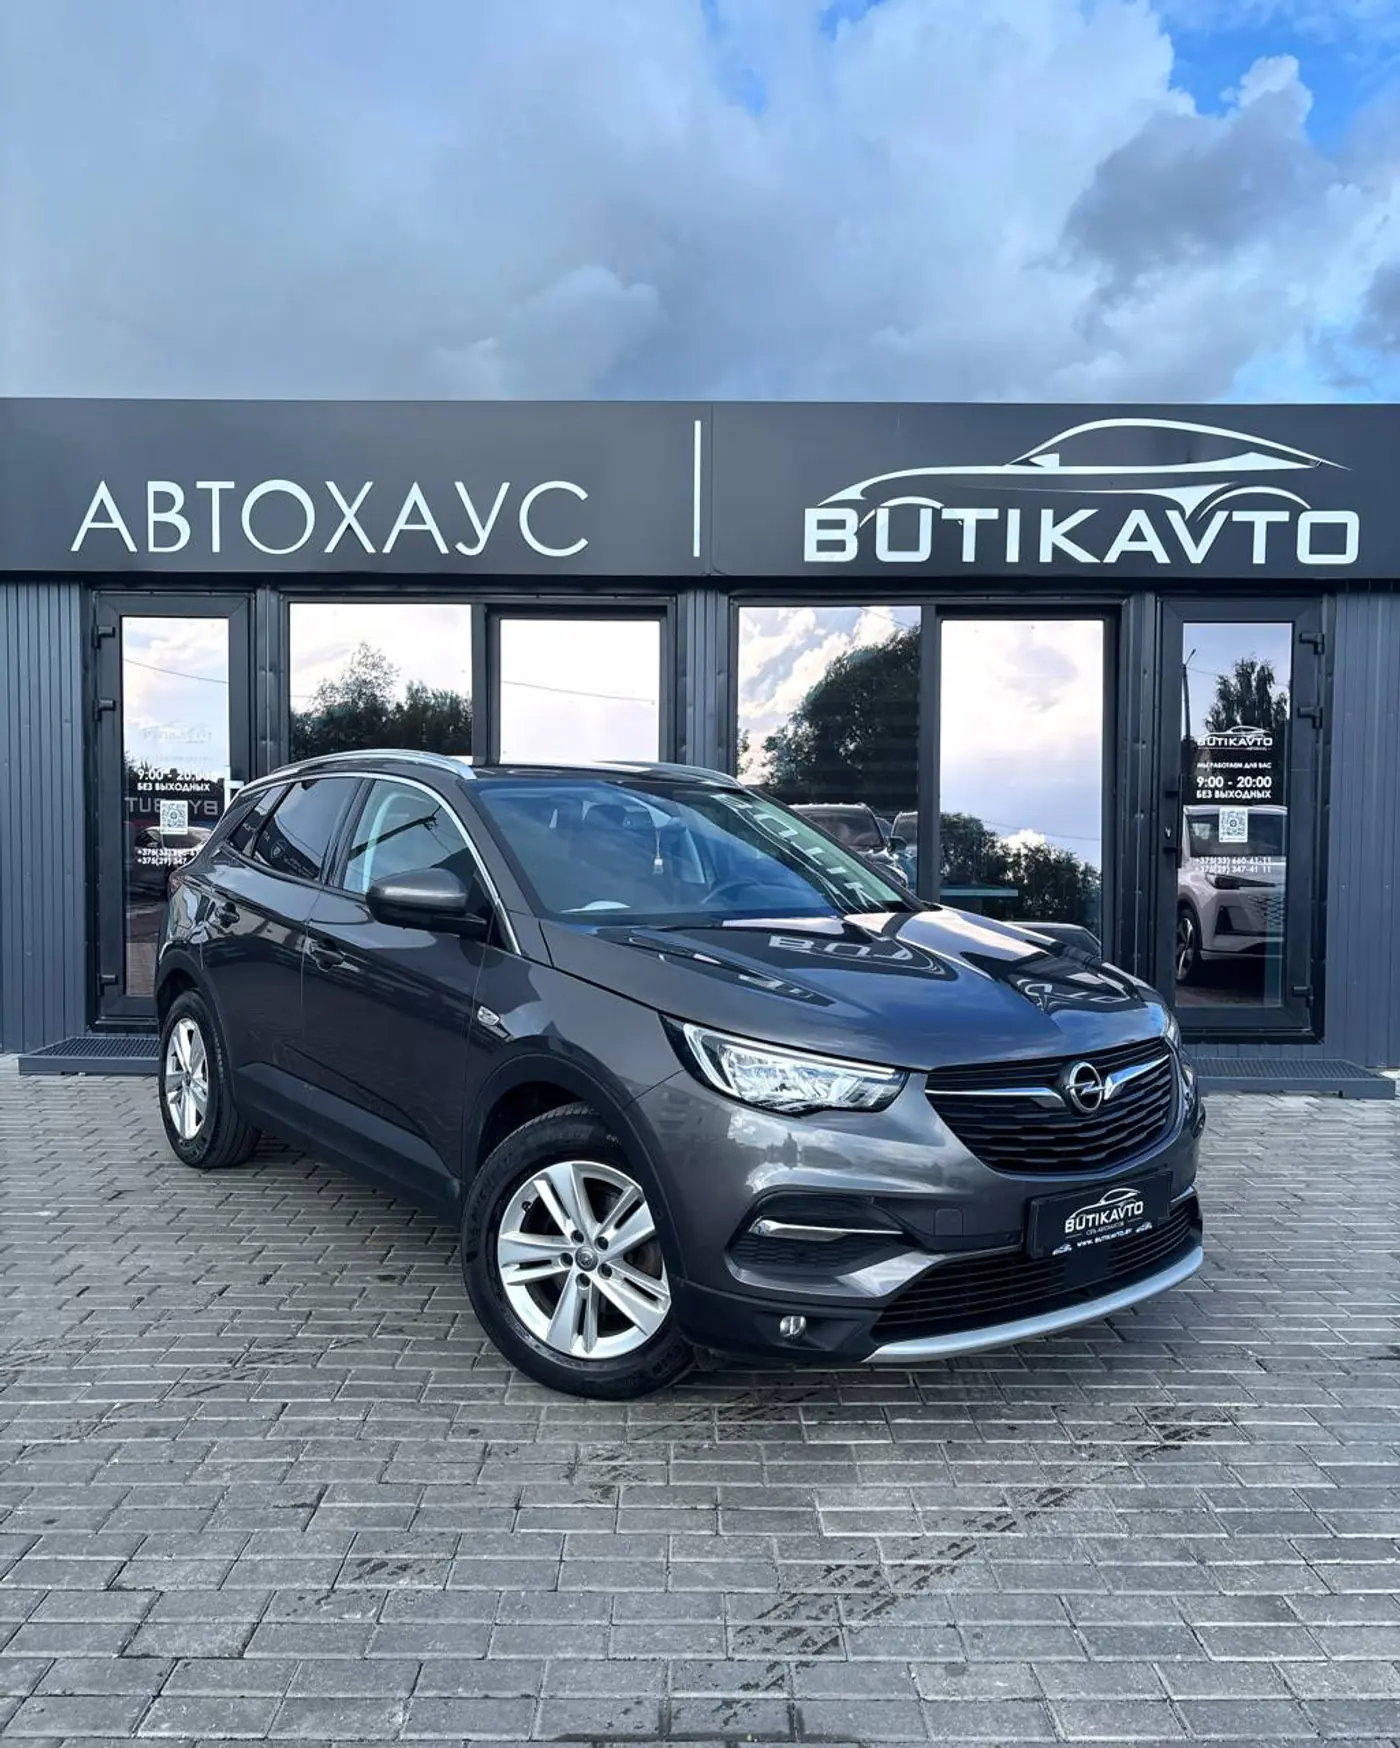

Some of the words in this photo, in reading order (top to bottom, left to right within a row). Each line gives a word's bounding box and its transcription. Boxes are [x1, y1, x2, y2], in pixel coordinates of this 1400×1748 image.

[70, 479, 589, 557] АВТОХАУС
[803, 507, 1361, 565] BUTIKAVTO
[1196, 737, 1273, 746] BUTIKAVTO
[137, 768, 164, 781] 9:00
[137, 783, 152, 791] БЕЗ
[155, 783, 210, 792] ВЫХОДНЫХ
[1196, 776, 1224, 788] 9:00
[1236, 776, 1272, 788] 20:00
[1196, 790, 1213, 799] БЕЗ
[1214, 790, 1272, 799] ВЫХОДНЫХ
[1065, 1201, 1144, 1233] BUTIKAVTO
